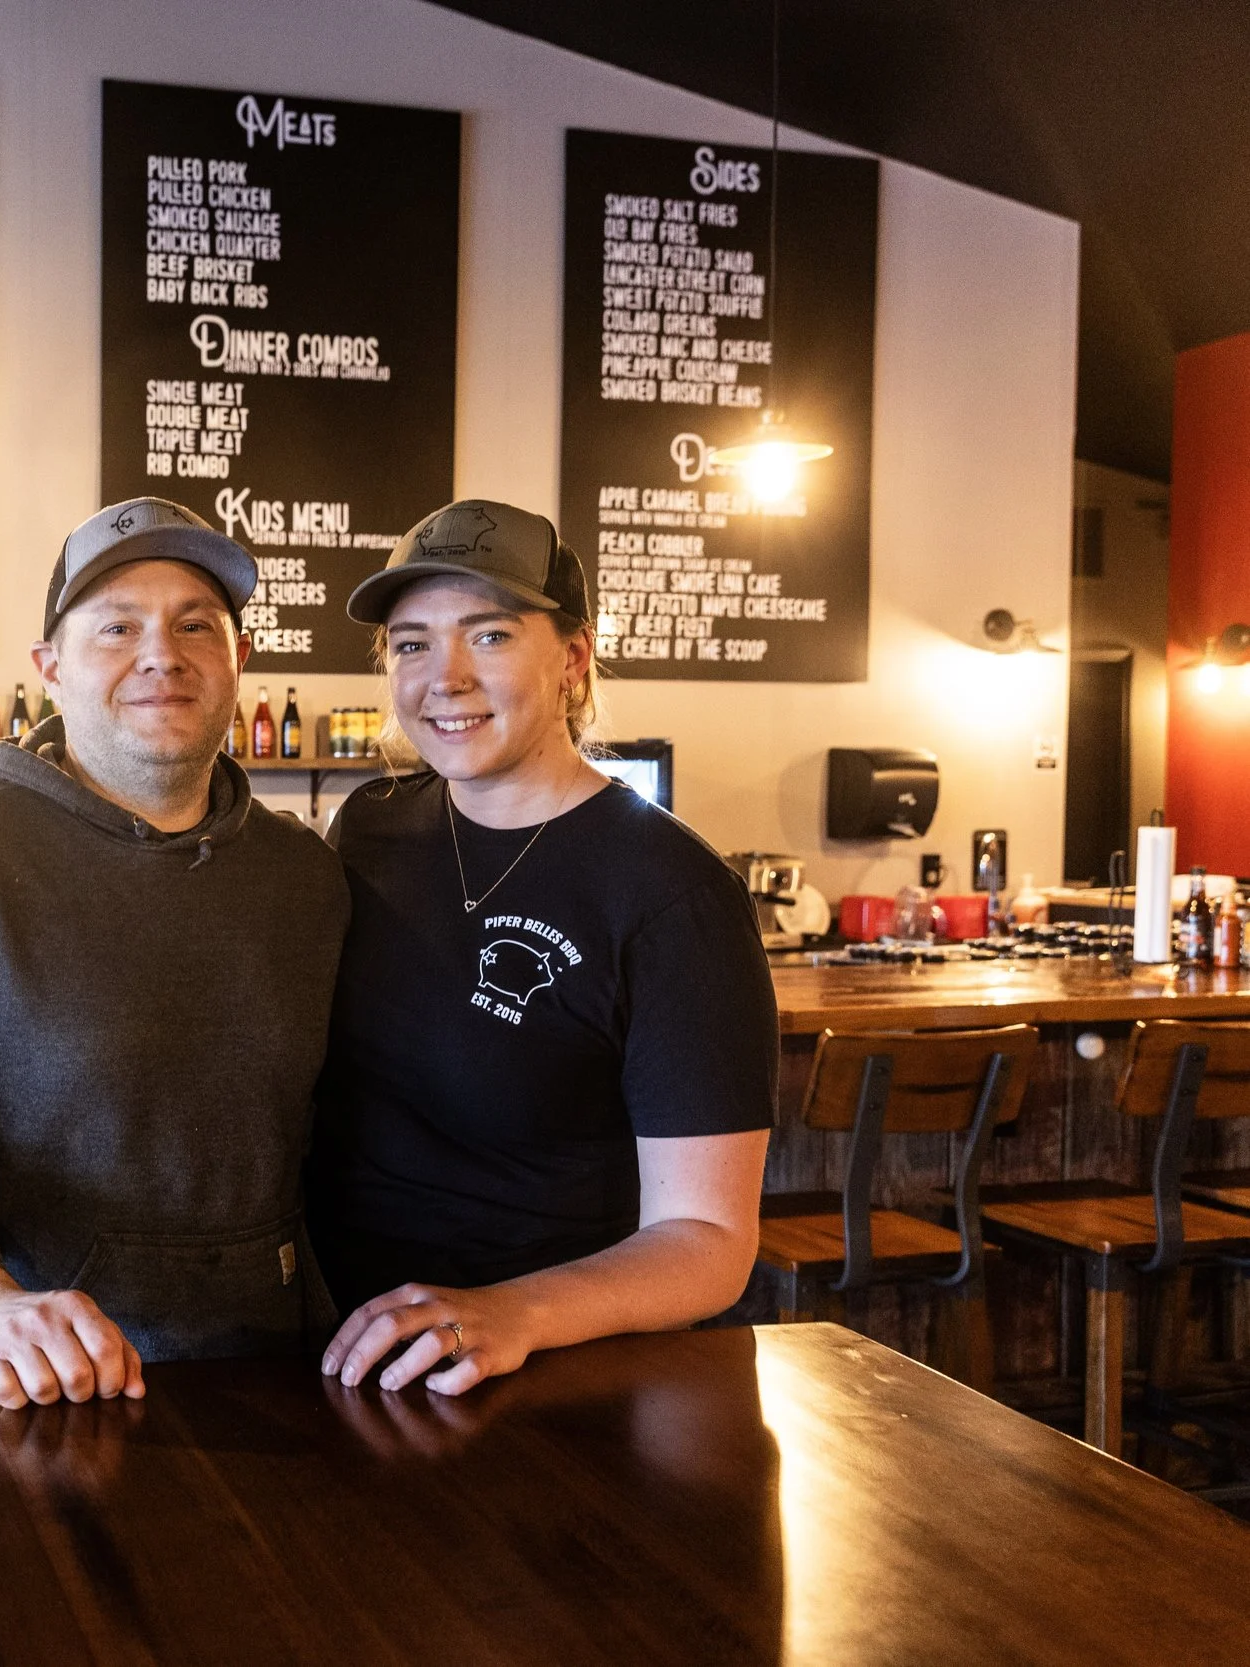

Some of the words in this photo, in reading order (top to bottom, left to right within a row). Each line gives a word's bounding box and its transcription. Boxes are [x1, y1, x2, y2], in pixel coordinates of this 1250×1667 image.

[236, 96, 336, 150] MEATS
[147, 155, 203, 182] PULLED
[208, 159, 247, 185] PORK
[690, 146, 760, 195] SIDES
[147, 180, 203, 206] PULLED
[208, 184, 271, 211] CHICKEN
[147, 204, 209, 231] SMOKED
[214, 209, 281, 237] SAUSAGE
[604, 193, 660, 220] SMOKED
[698, 201, 738, 228] FRIES
[147, 229, 210, 255] CHICKEN
[215, 234, 281, 261] QUARTER
[659, 221, 699, 246] FRIES
[603, 239, 659, 265] SMOKED
[146, 253, 188, 279] BEEF
[193, 256, 254, 284] BRISKET
[146, 278, 186, 304] BABY
[191, 280, 229, 306] BACK
[234, 283, 268, 309] RIBS
[190, 314, 289, 368] DINNER
[297, 334, 379, 366] COMBOS
[601, 331, 657, 357] SMOKED
[721, 338, 772, 365] CHEESE
[146, 379, 196, 405] SINGLE
[201, 382, 244, 407] MEAT
[601, 377, 657, 402] SMOKED
[146, 404, 201, 430] DOUBLE
[206, 406, 249, 431] MEAT
[146, 428, 195, 453] TRIPLE
[201, 430, 243, 455] MEAT
[146, 452, 172, 477] RIB
[177, 454, 229, 479] COMBO
[215, 487, 285, 539] KIDS
[293, 501, 350, 533] MENU
[288, 532, 310, 546] WITH
[352, 533, 402, 549] APPLESAUC
[598, 530, 644, 555] PEACH
[257, 557, 306, 581] LIDERS
[268, 582, 326, 606] SLIDERS
[242, 606, 278, 628] DERS
[254, 629, 312, 653] CHEESE
[674, 637, 693, 660] BY
[696, 638, 721, 661] THE
[724, 638, 768, 662] SCOOP
[484, 915, 522, 929] PIPER
[523, 917, 564, 944] BELLES
[559, 939, 583, 966] BBQ
[470, 991, 491, 1011] EST.
[493, 1003, 523, 1025] 2015
